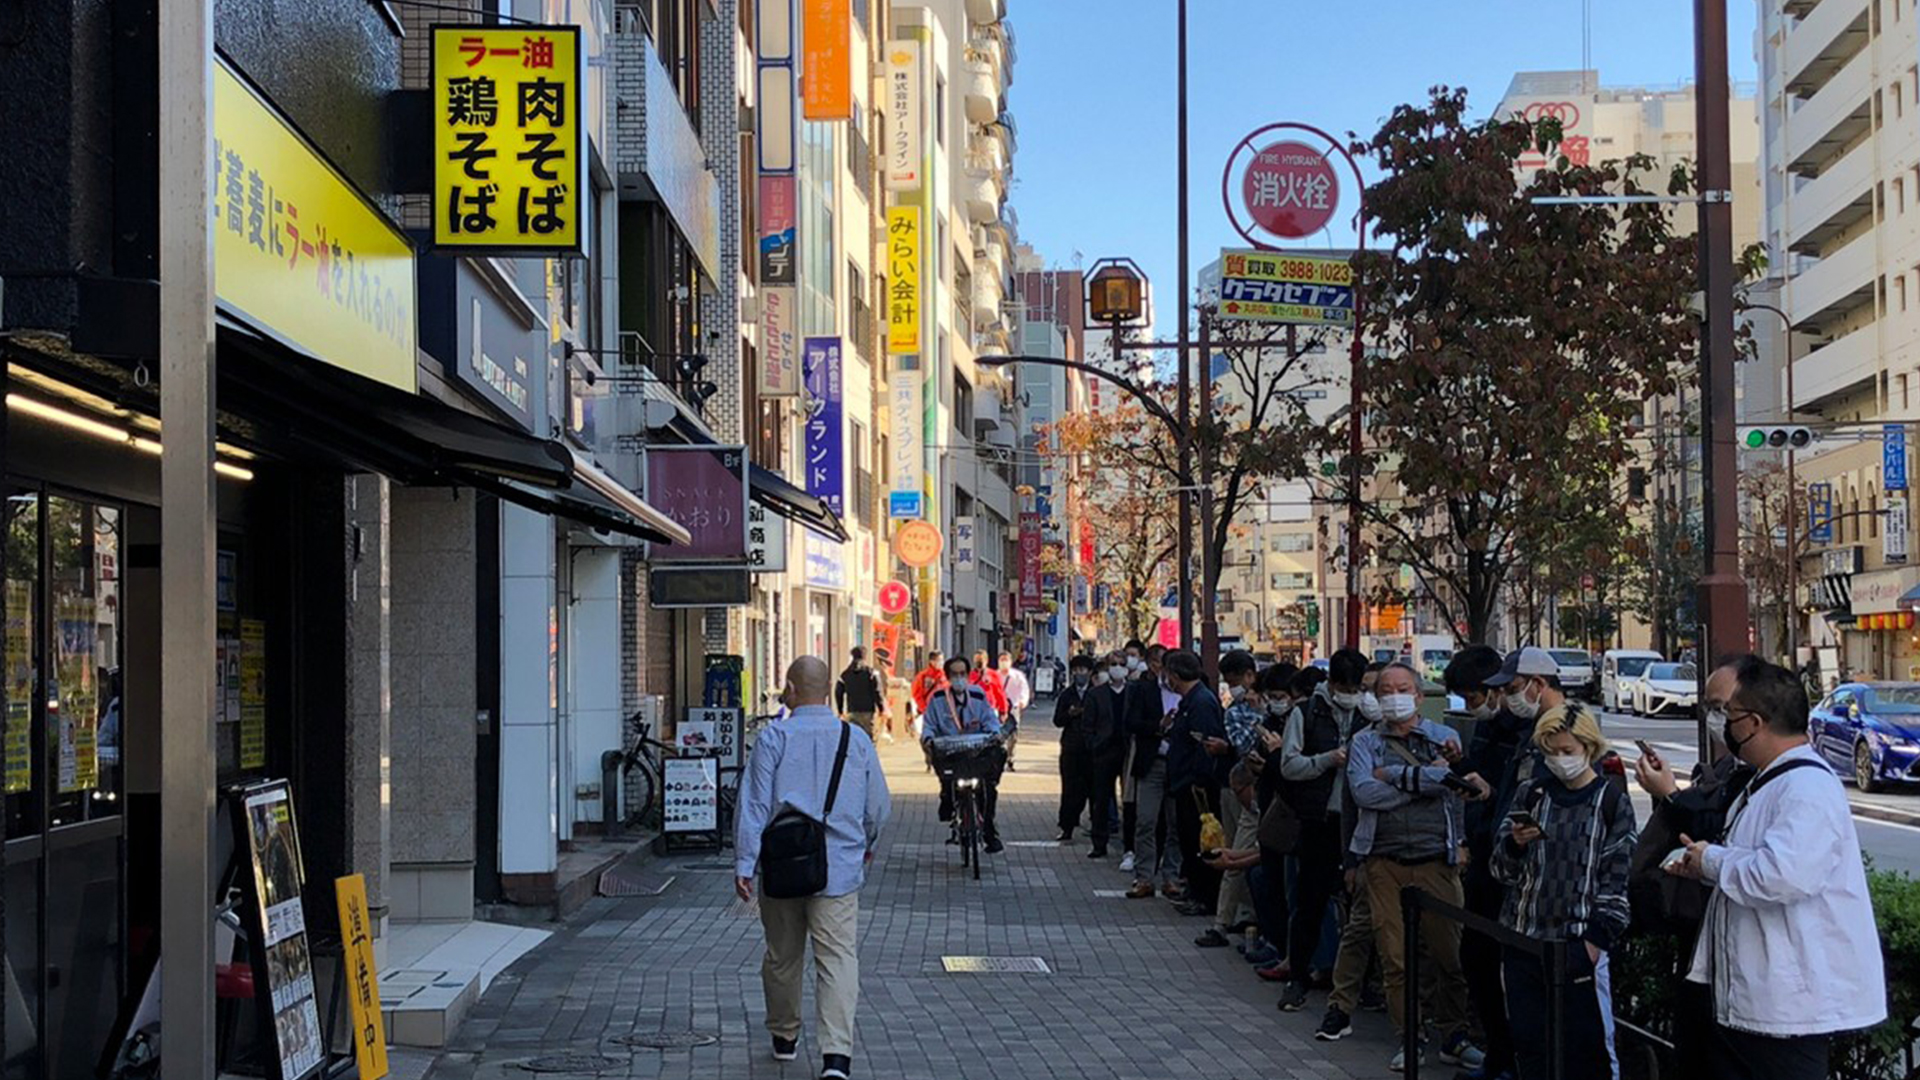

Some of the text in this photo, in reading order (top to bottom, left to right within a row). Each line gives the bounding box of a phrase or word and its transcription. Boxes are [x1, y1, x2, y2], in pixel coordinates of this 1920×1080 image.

[459, 37, 553, 68] ラー油
[447, 76, 499, 234] 鶏そば
[516, 76, 568, 234] 肉そば
[1259, 154, 1322, 166] FIRE HYDRANT
[1252, 171, 1331, 209] 消火栓
[890, 216, 916, 324] みらい会計
[1223, 280, 1349, 306] クラタセブン
[809, 351, 827, 488] アークランド
[957, 524, 973, 563] 写真
